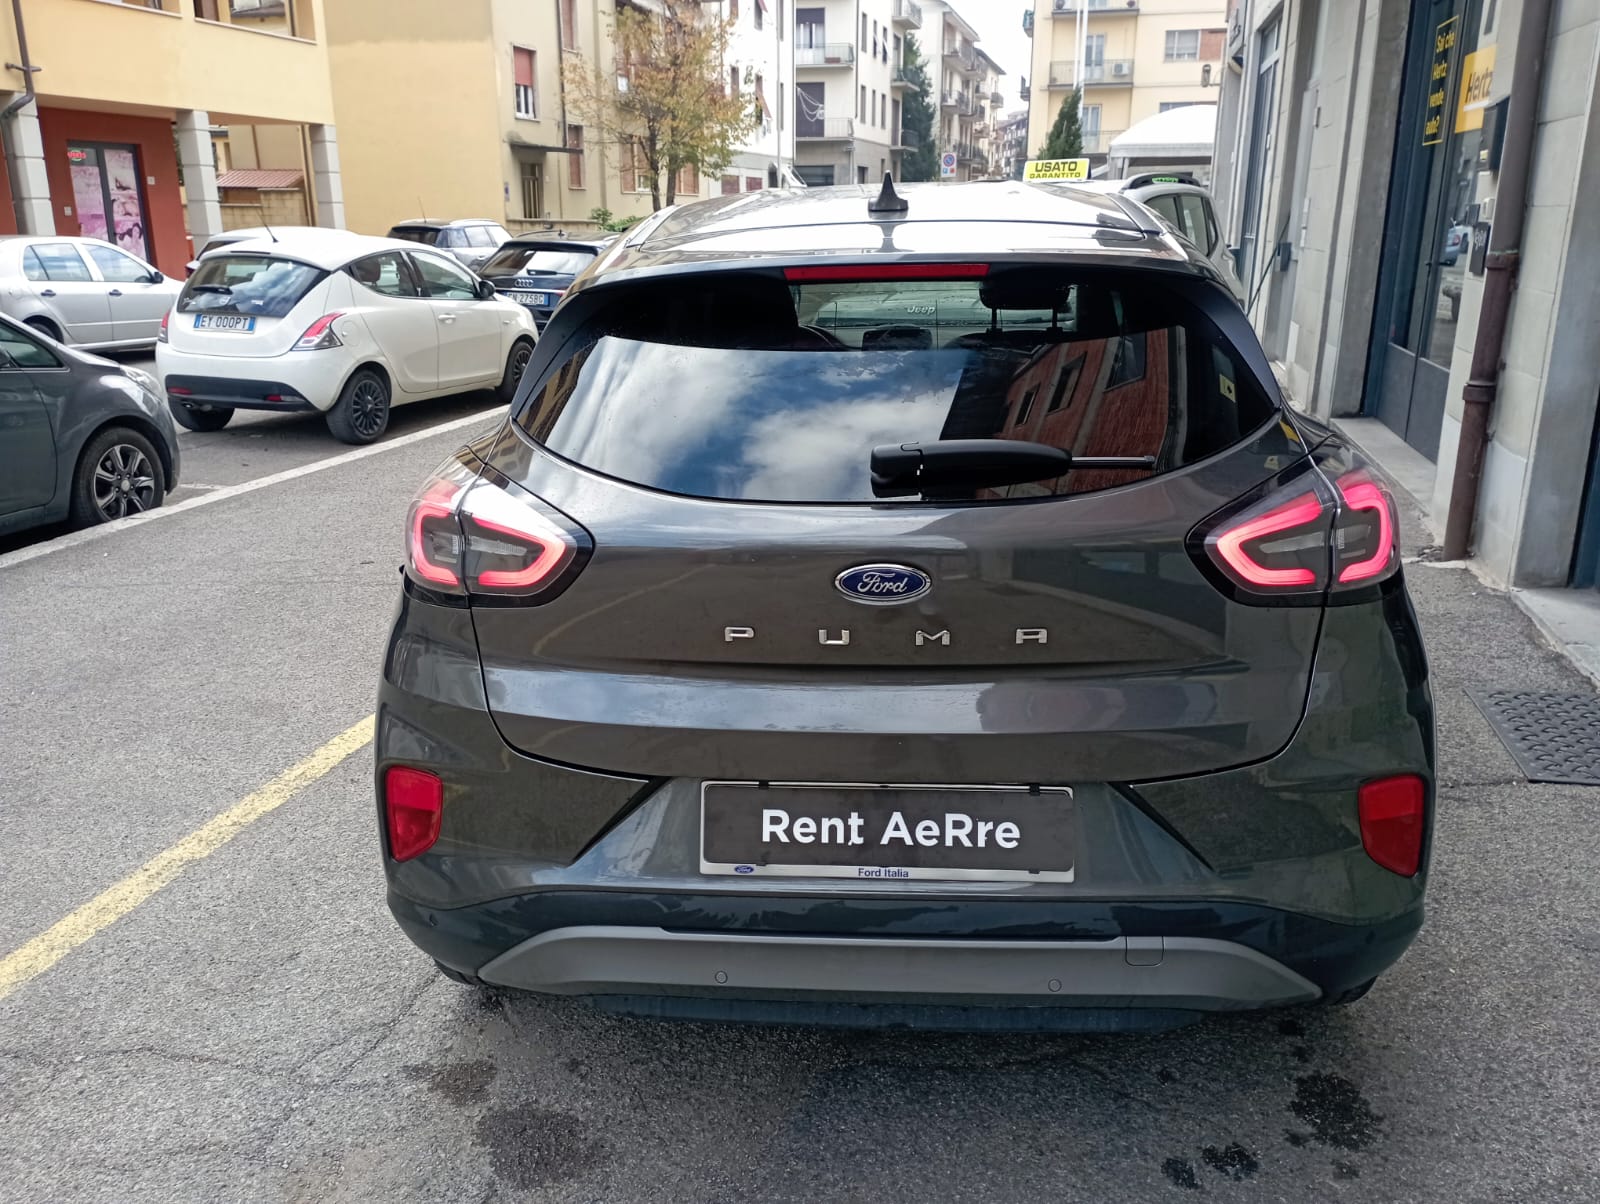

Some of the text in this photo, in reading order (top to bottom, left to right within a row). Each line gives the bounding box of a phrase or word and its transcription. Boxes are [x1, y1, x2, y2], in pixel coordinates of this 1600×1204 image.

[1465, 67, 1493, 104] Hertz
[1035, 161, 1078, 172] USATO
[907, 305, 935, 314] Jeep
[201, 315, 214, 327] EY
[857, 572, 908, 594] Ford
[724, 626, 1048, 646] PUMA
[762, 808, 1021, 849] Rent AeRre
[858, 867, 909, 878] Ford Italia
